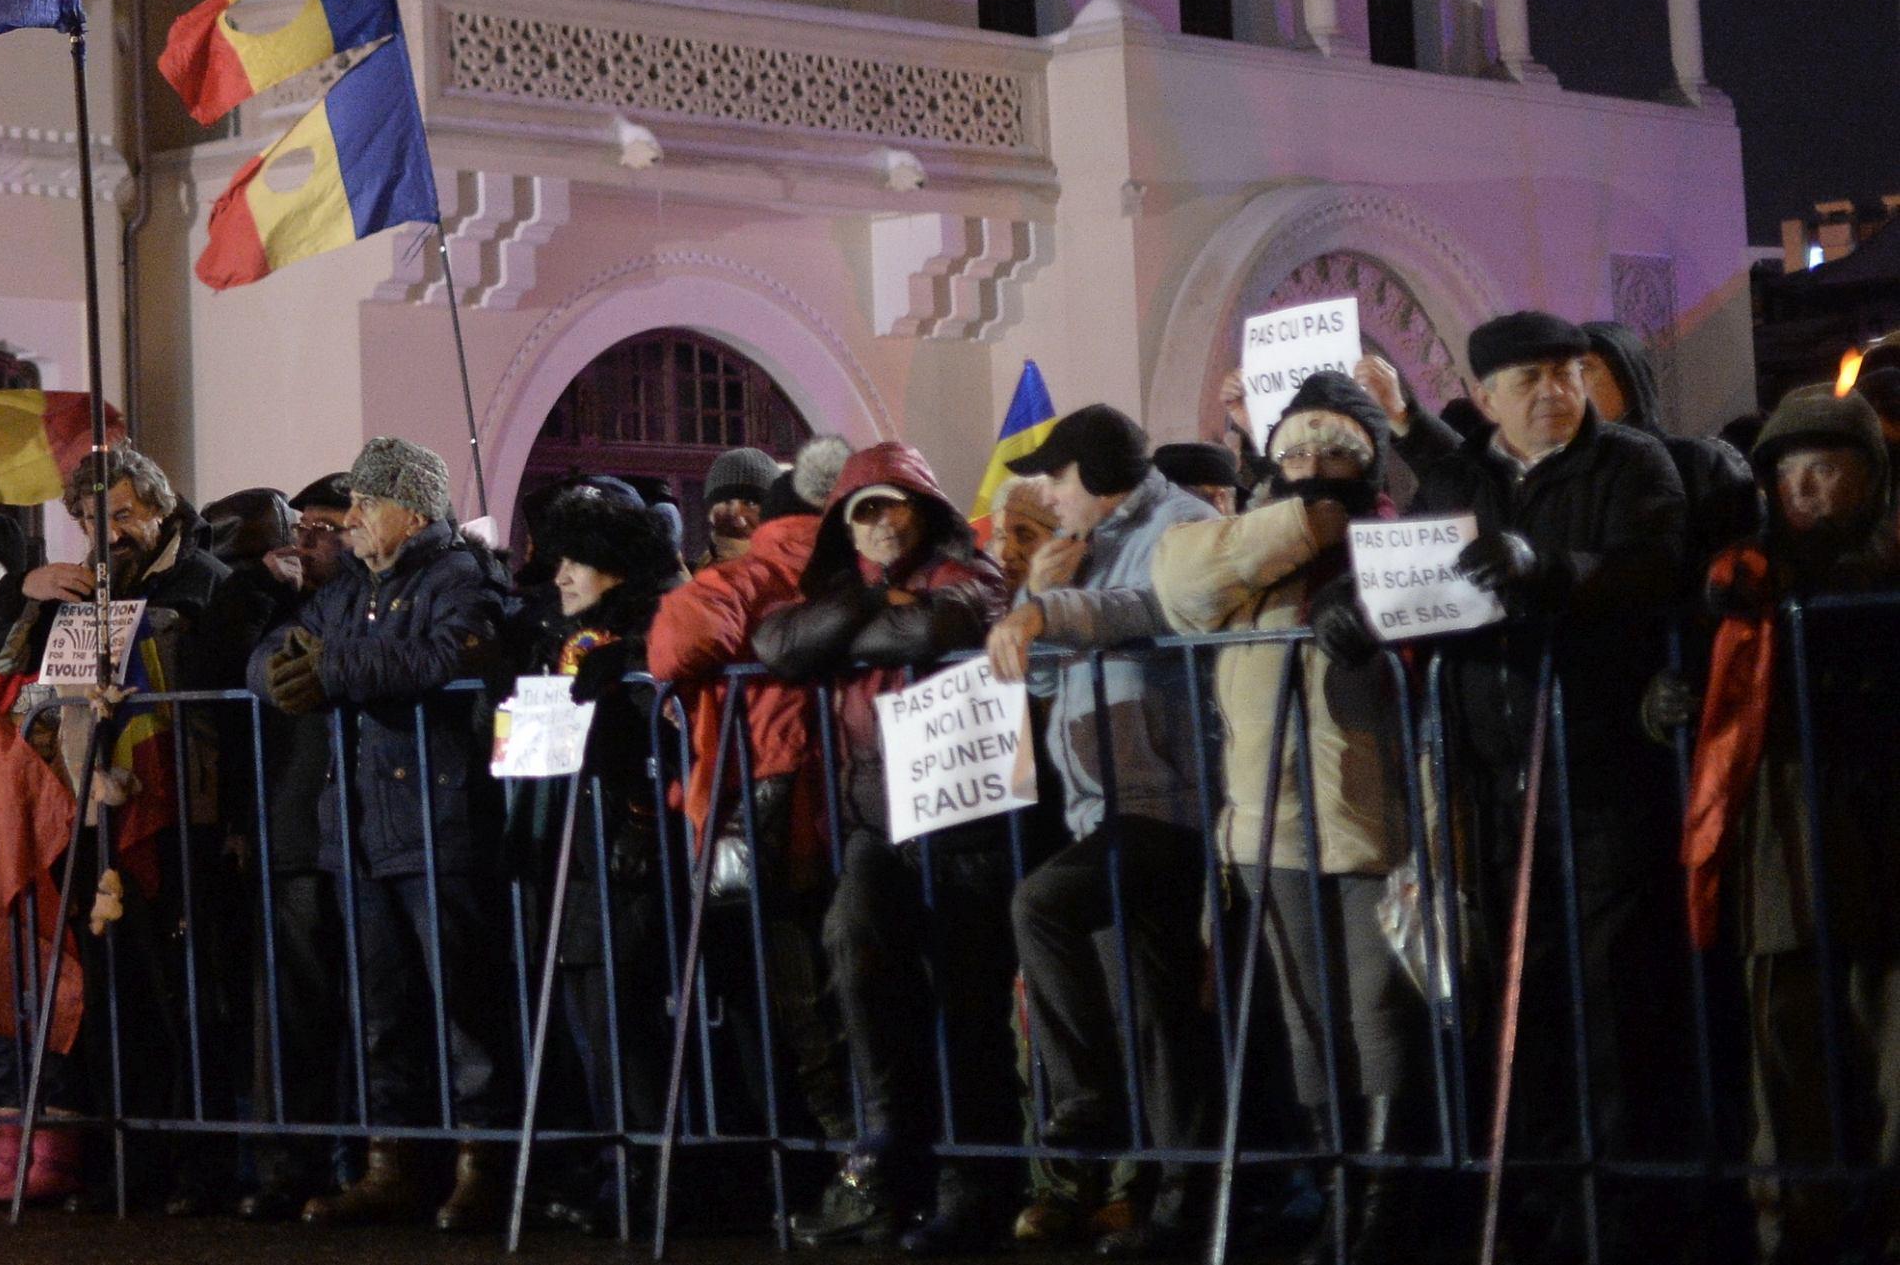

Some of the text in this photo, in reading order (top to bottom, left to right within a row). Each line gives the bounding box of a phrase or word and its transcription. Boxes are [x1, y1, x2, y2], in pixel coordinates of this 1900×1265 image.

[1278, 318, 1299, 342] CU
[1303, 311, 1344, 337] PAS
[1248, 371, 1286, 395] VOM
[1355, 525, 1460, 549] PAS CU PAS
[1381, 603, 1461, 628] DE SAS
[52, 638, 66, 649] 19
[893, 687, 934, 723] PAS
[941, 671, 970, 700] CU
[925, 709, 964, 742] NOI
[911, 730, 1020, 783] SPUNEM
[913, 774, 1006, 822] RAUS
